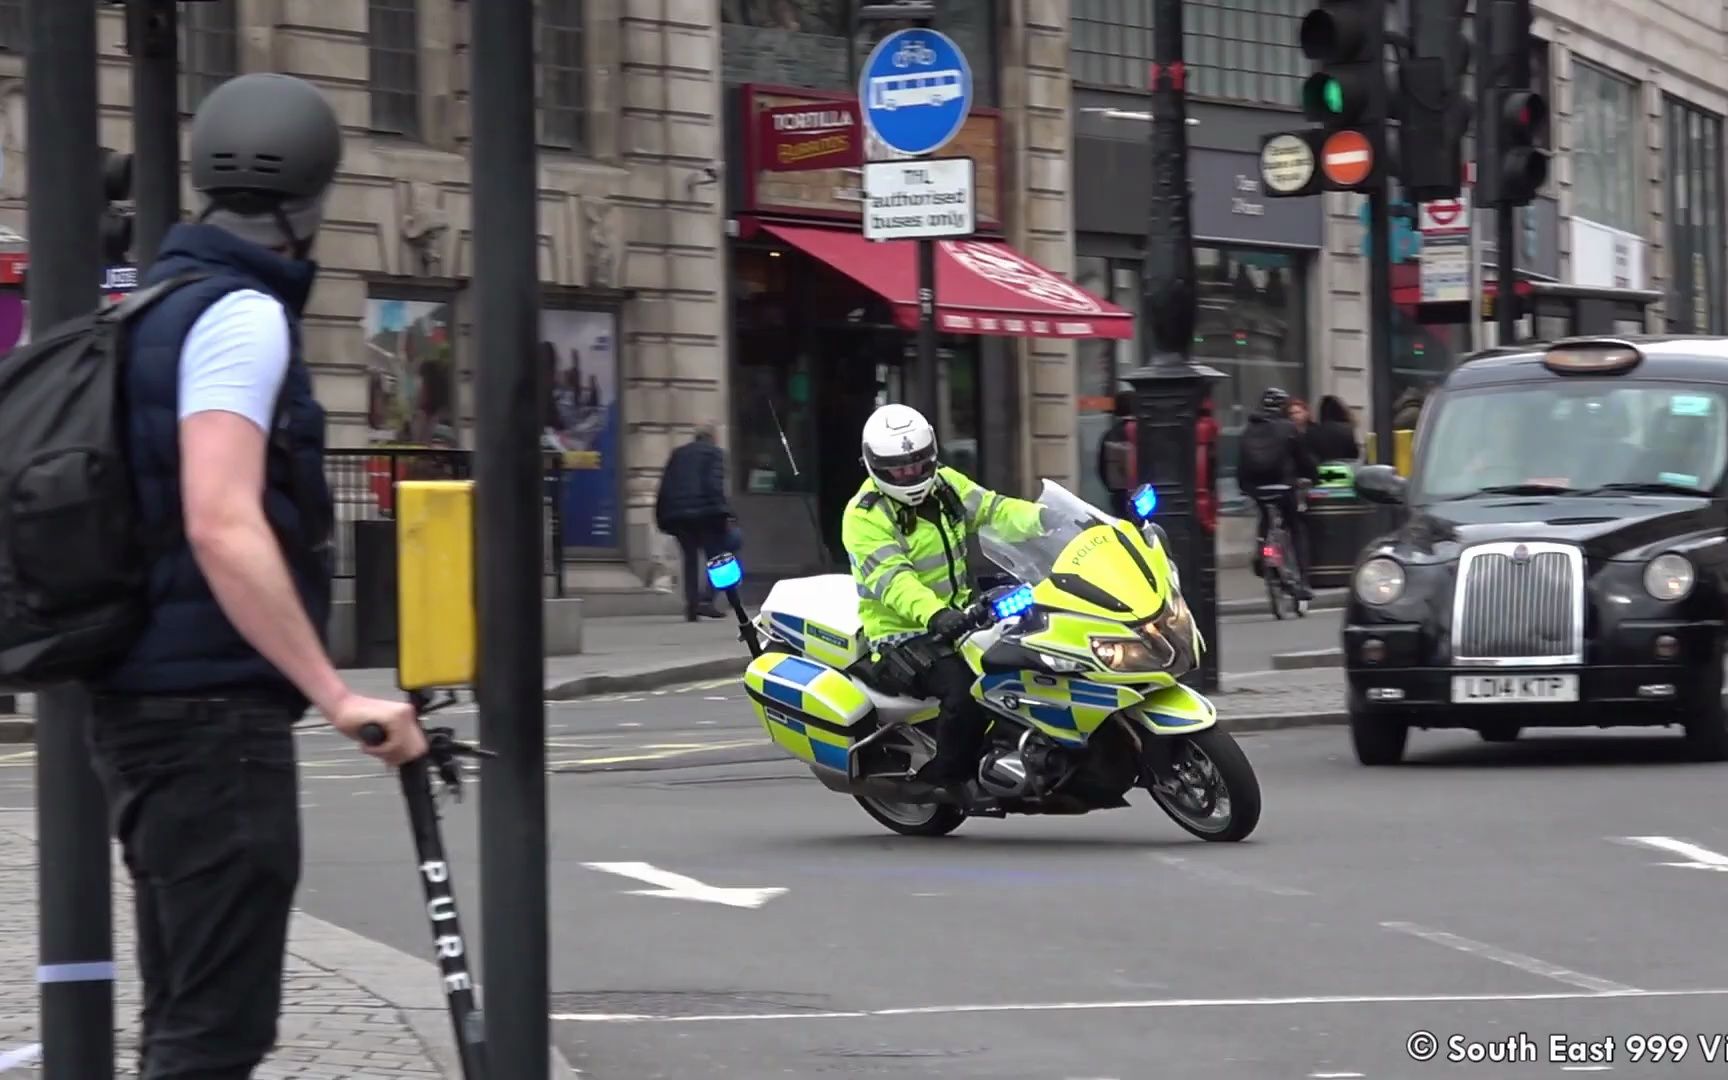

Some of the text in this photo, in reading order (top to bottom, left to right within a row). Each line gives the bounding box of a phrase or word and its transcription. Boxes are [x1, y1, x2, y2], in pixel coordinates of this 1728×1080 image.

[772, 111, 855, 130] TORTILLA
[871, 188, 966, 209] authorised
[871, 210, 965, 230] buses only
[1071, 535, 1110, 567] POLICE
[1519, 677, 1564, 697] KTP
[418, 861, 472, 993] PURE
